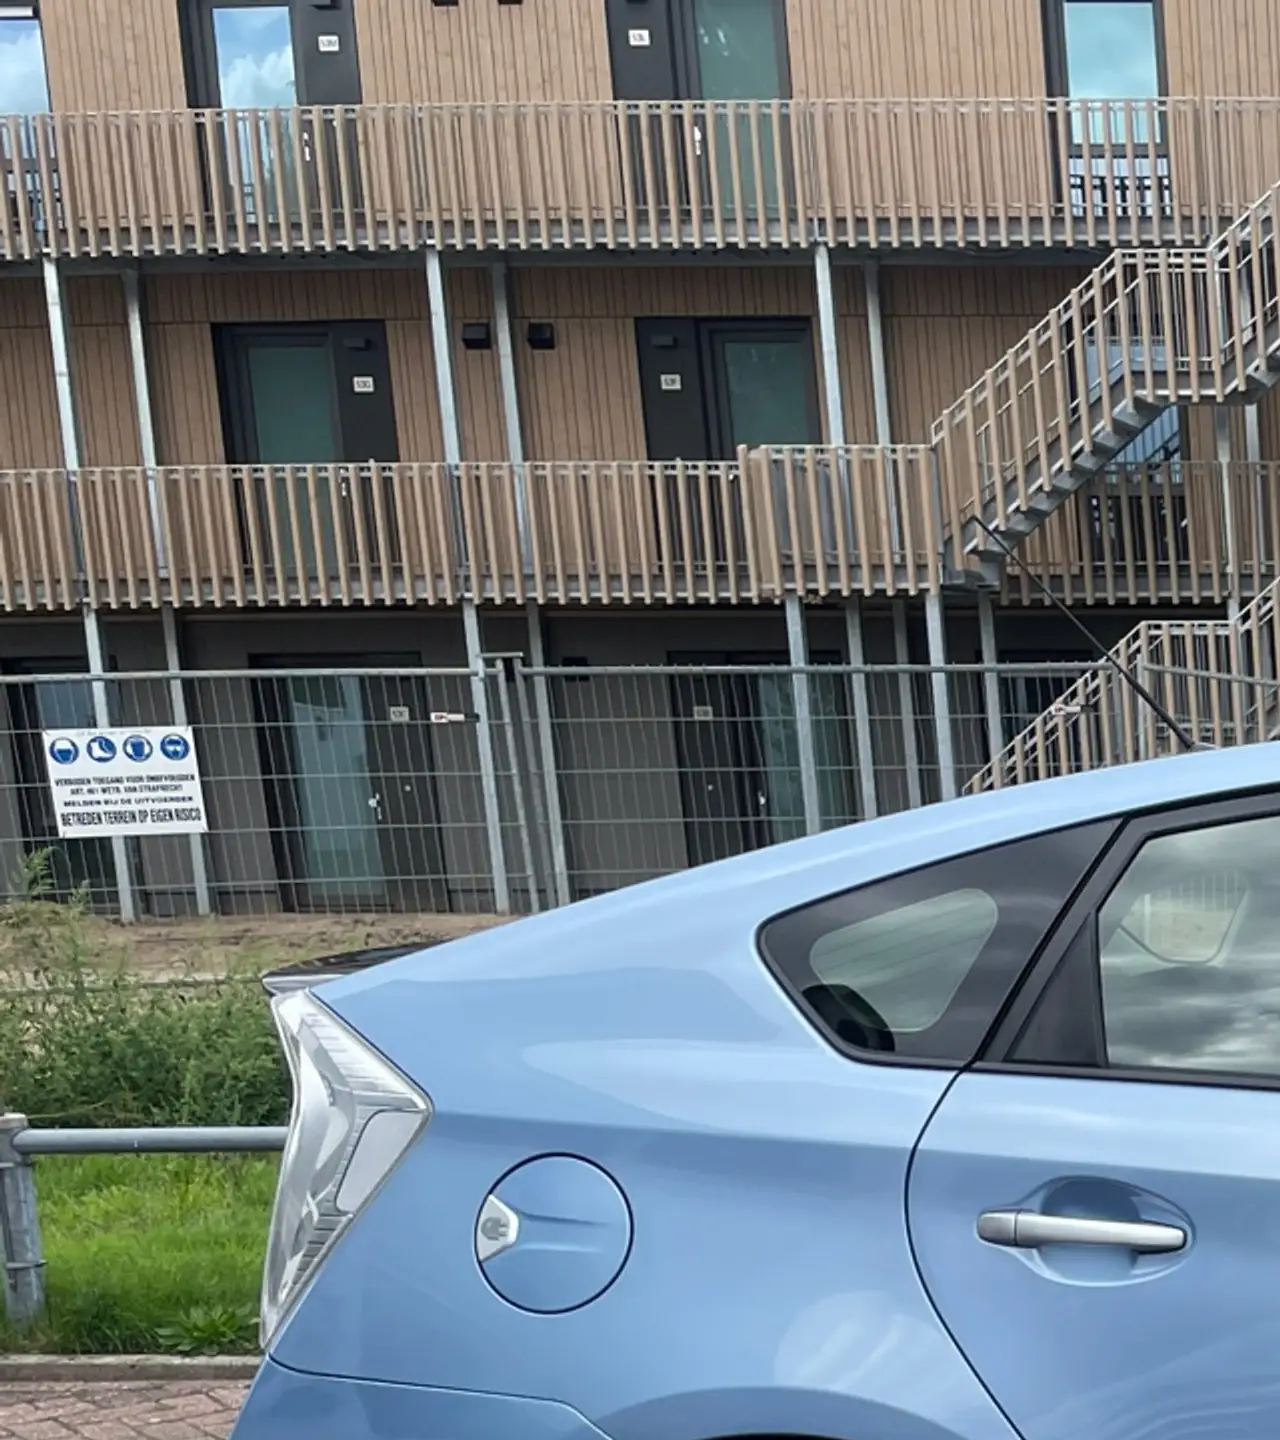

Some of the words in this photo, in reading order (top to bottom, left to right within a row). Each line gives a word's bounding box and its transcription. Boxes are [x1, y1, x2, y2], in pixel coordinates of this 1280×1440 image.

[54, 777, 92, 787] VERBODEN
[92, 776, 125, 786] TOEGANG
[126, 775, 145, 784] VOOR
[64, 799, 102, 807] MELDEN
[103, 798, 119, 806] BIJ
[120, 797, 132, 805] DE
[134, 795, 194, 805] UITVOERDER
[61, 811, 103, 827] BETREDEN
[103, 809, 137, 825] TERREIN
[138, 808, 149, 824] OP
[150, 807, 174, 823] EIGEN
[174, 805, 202, 821] RISICO
